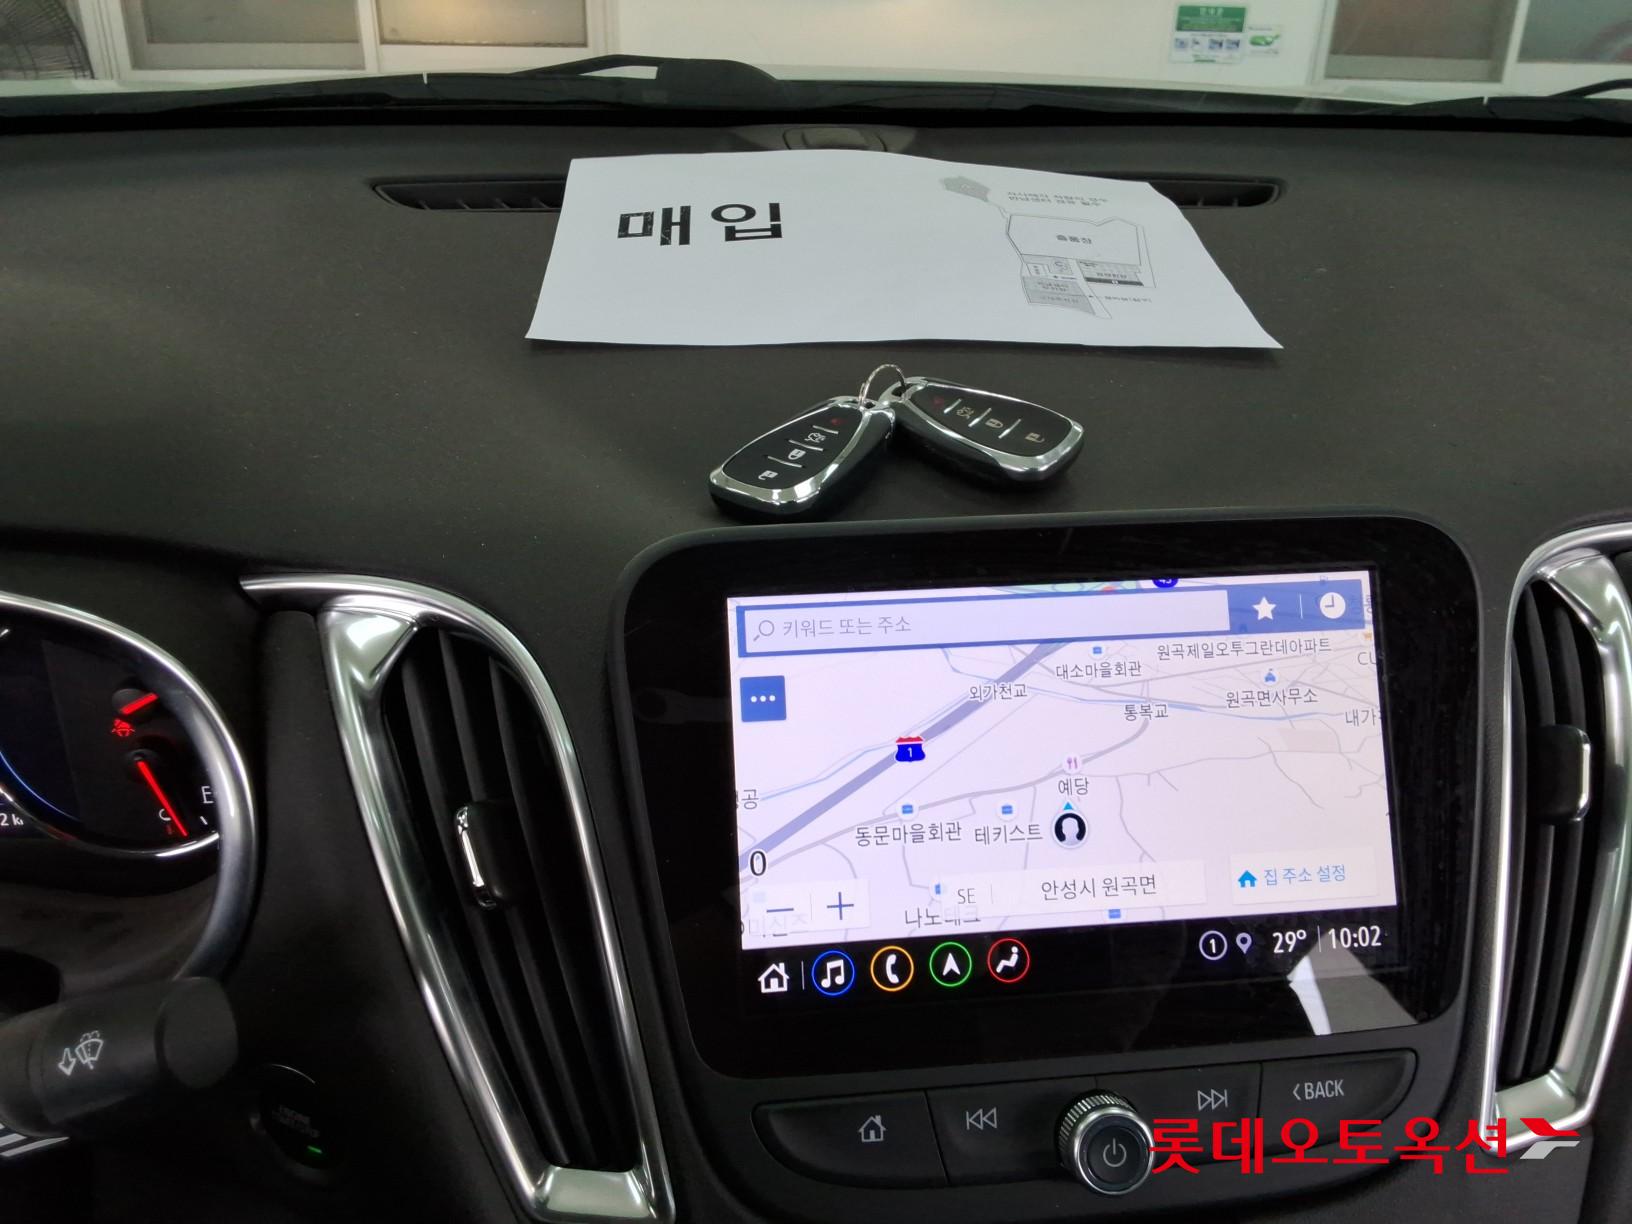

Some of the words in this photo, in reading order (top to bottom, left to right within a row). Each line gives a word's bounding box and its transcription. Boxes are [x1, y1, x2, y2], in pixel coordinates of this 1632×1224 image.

[783, 619, 835, 638] 키워드
[839, 617, 873, 635] 또는
[877, 615, 912, 634] 주소
[1156, 638, 1332, 661] 원곡제일오투그란데아파트
[1056, 660, 1142, 680] 대소마을회관
[969, 682, 1028, 702] 외가천교
[1225, 688, 1318, 709] 원곡면사무소
[1124, 703, 1169, 721] 통복교
[1346, 709, 1380, 727] 내가
[201, 785, 214, 804] E
[1058, 777, 1090, 796] 예당
[855, 821, 962, 847] 동문마을회관
[975, 823, 1043, 845] 테키스트
[748, 850, 768, 877] 0
[1264, 868, 1278, 886] 집
[1282, 866, 1313, 884] 주소
[1316, 864, 1346, 882] 설정
[957, 887, 976, 905] SE
[1041, 878, 1096, 900] 안성시
[1102, 874, 1157, 897] 원곡면
[1327, 925, 1382, 949] 10:02
[1304, 1079, 1344, 1100] BACK
